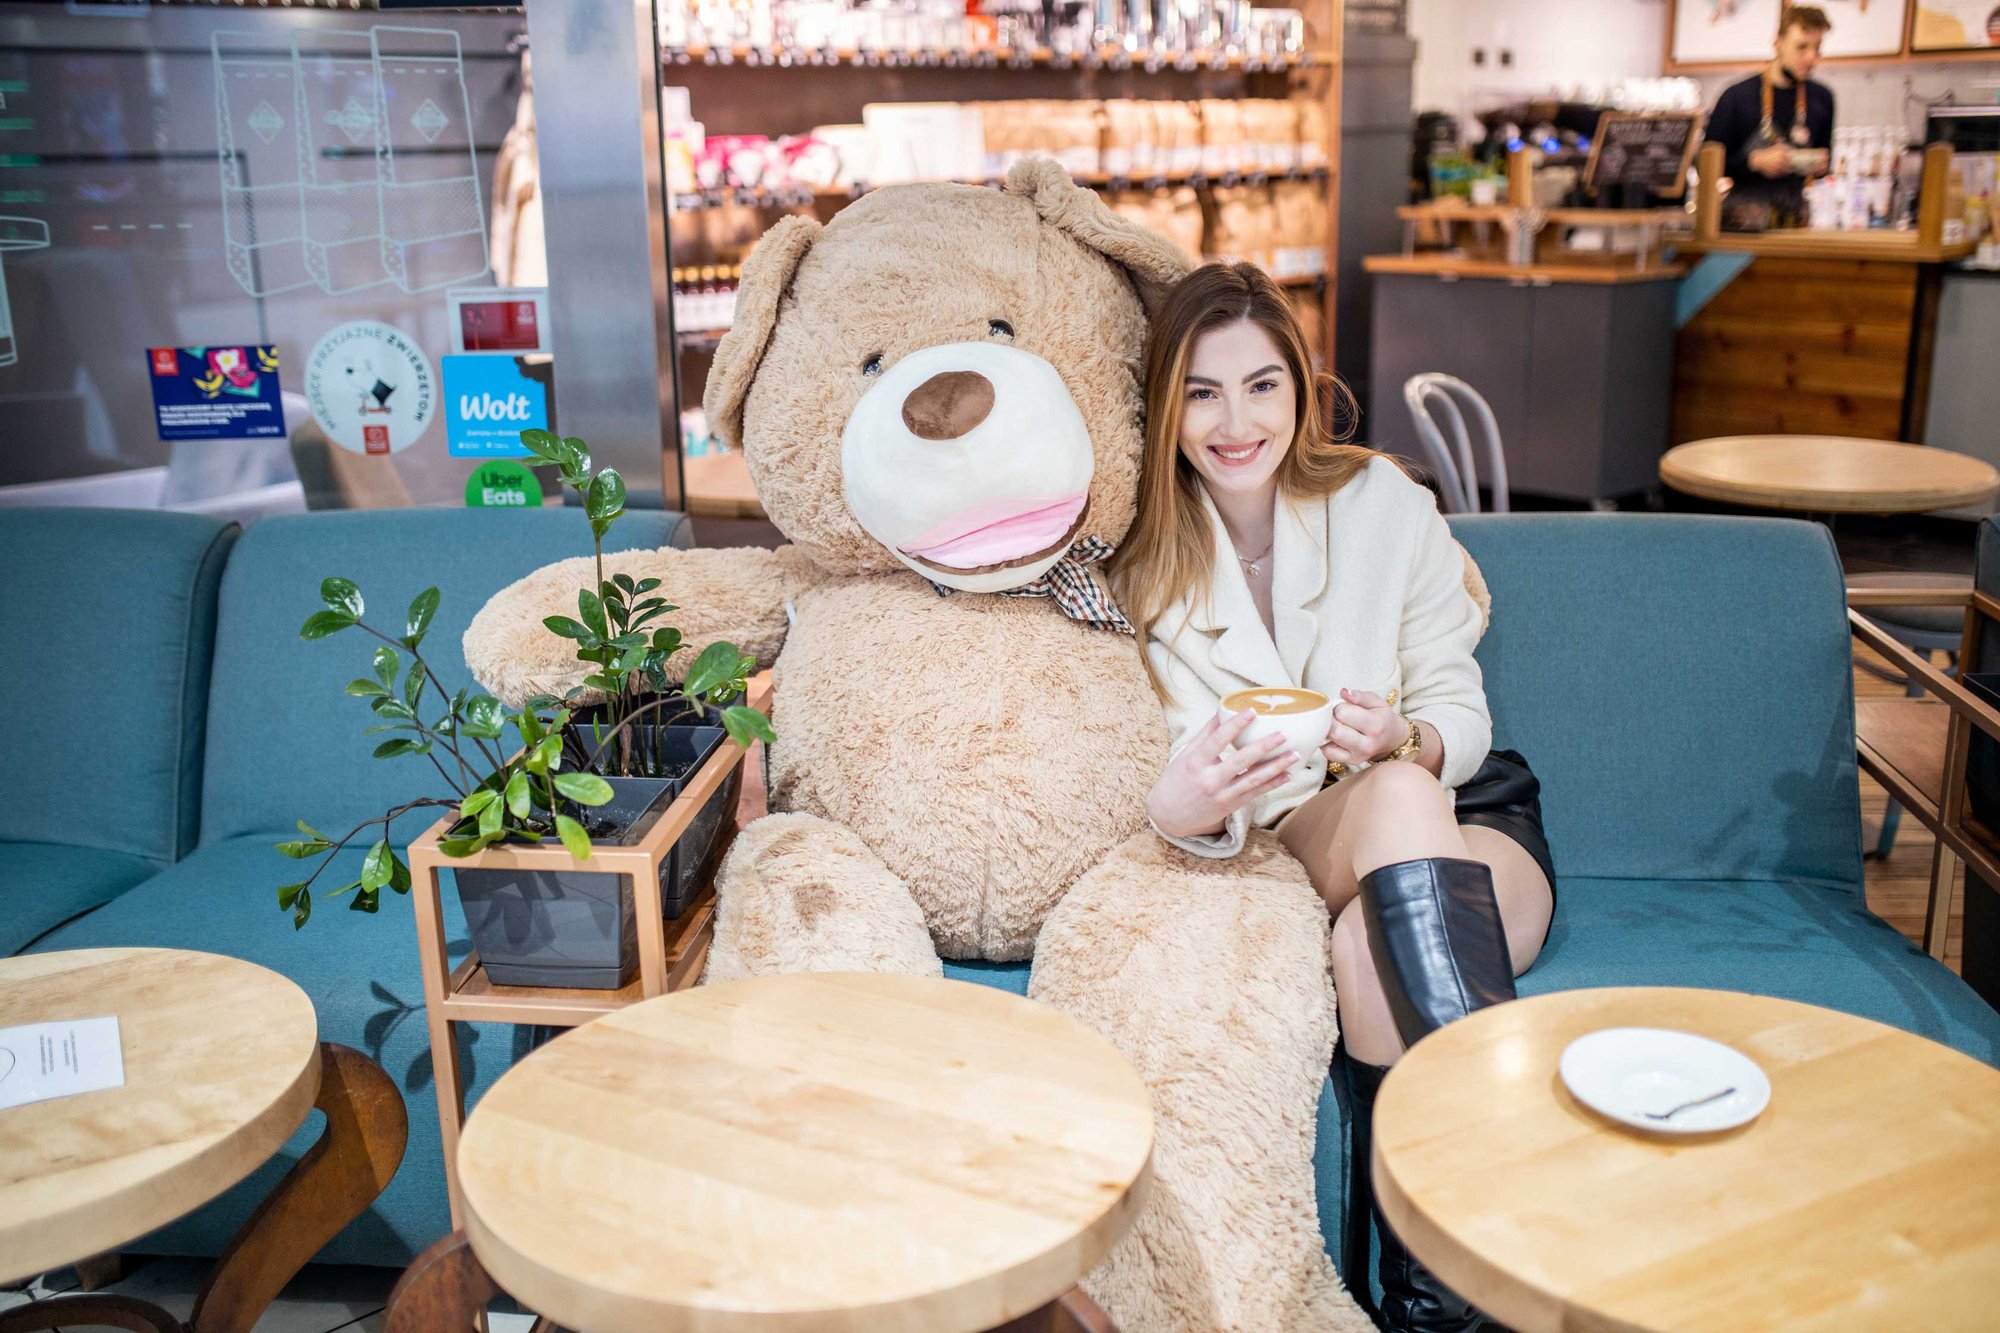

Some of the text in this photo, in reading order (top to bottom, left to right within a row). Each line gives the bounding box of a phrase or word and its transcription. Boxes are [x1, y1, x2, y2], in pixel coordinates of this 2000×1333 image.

[460, 392, 531, 421] Wolt
[481, 470, 523, 488] Uber
[482, 487, 526, 505] Eats
